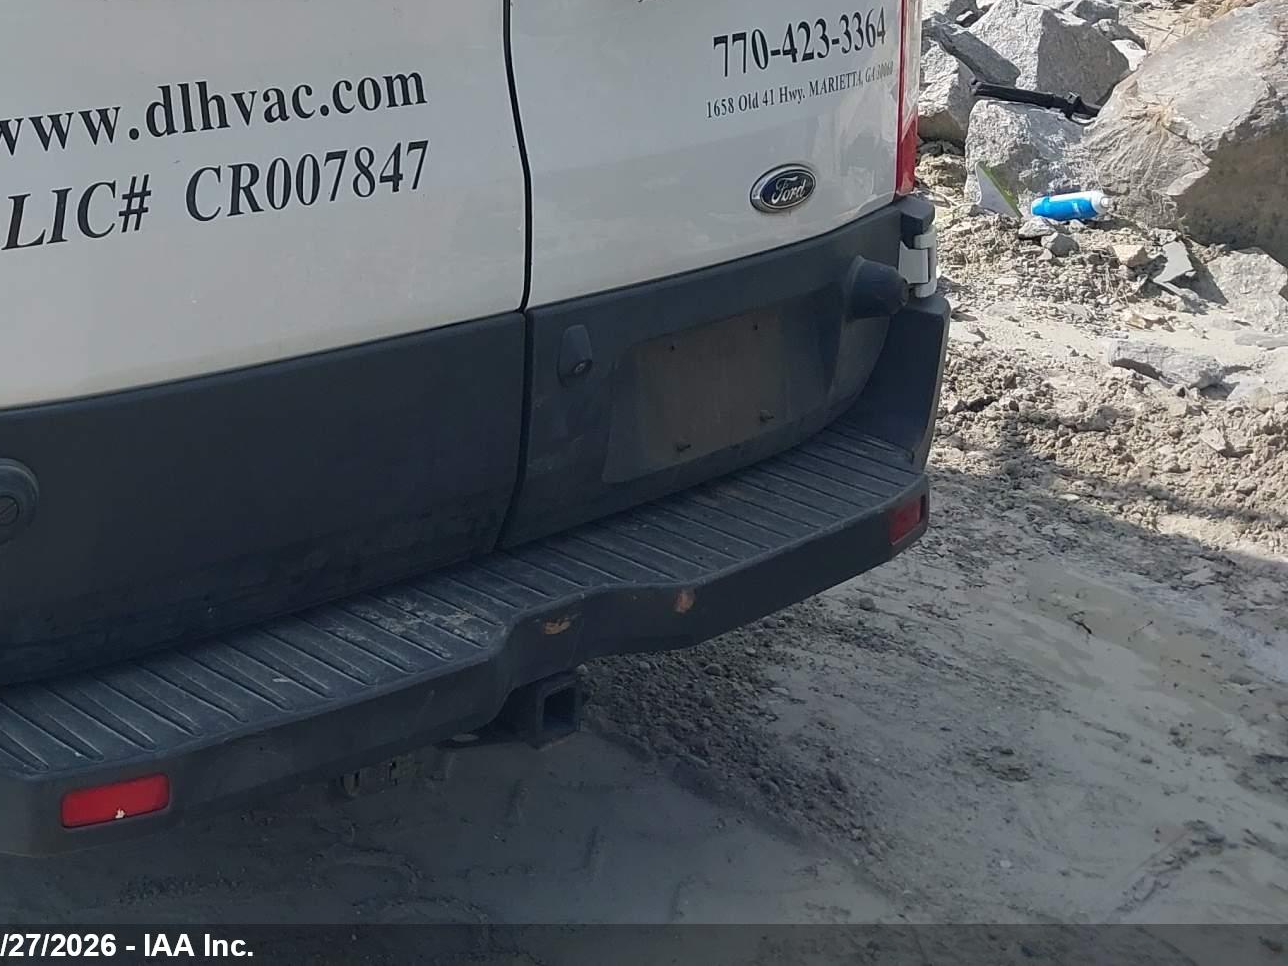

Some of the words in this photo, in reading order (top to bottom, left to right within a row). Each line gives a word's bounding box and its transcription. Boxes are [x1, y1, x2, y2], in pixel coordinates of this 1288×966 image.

[713, 7, 887, 77] 770-423-3364
[707, 98, 734, 118] 1658
[738, 92, 759, 112] Old
[762, 89, 774, 107] 41
[779, 86, 805, 104] Hwy.
[809, 71, 863, 97] MARIETTA,
[865, 66, 876, 83] GA
[1, 173, 152, 251] LIC#
[185, 139, 429, 222] CR007847
